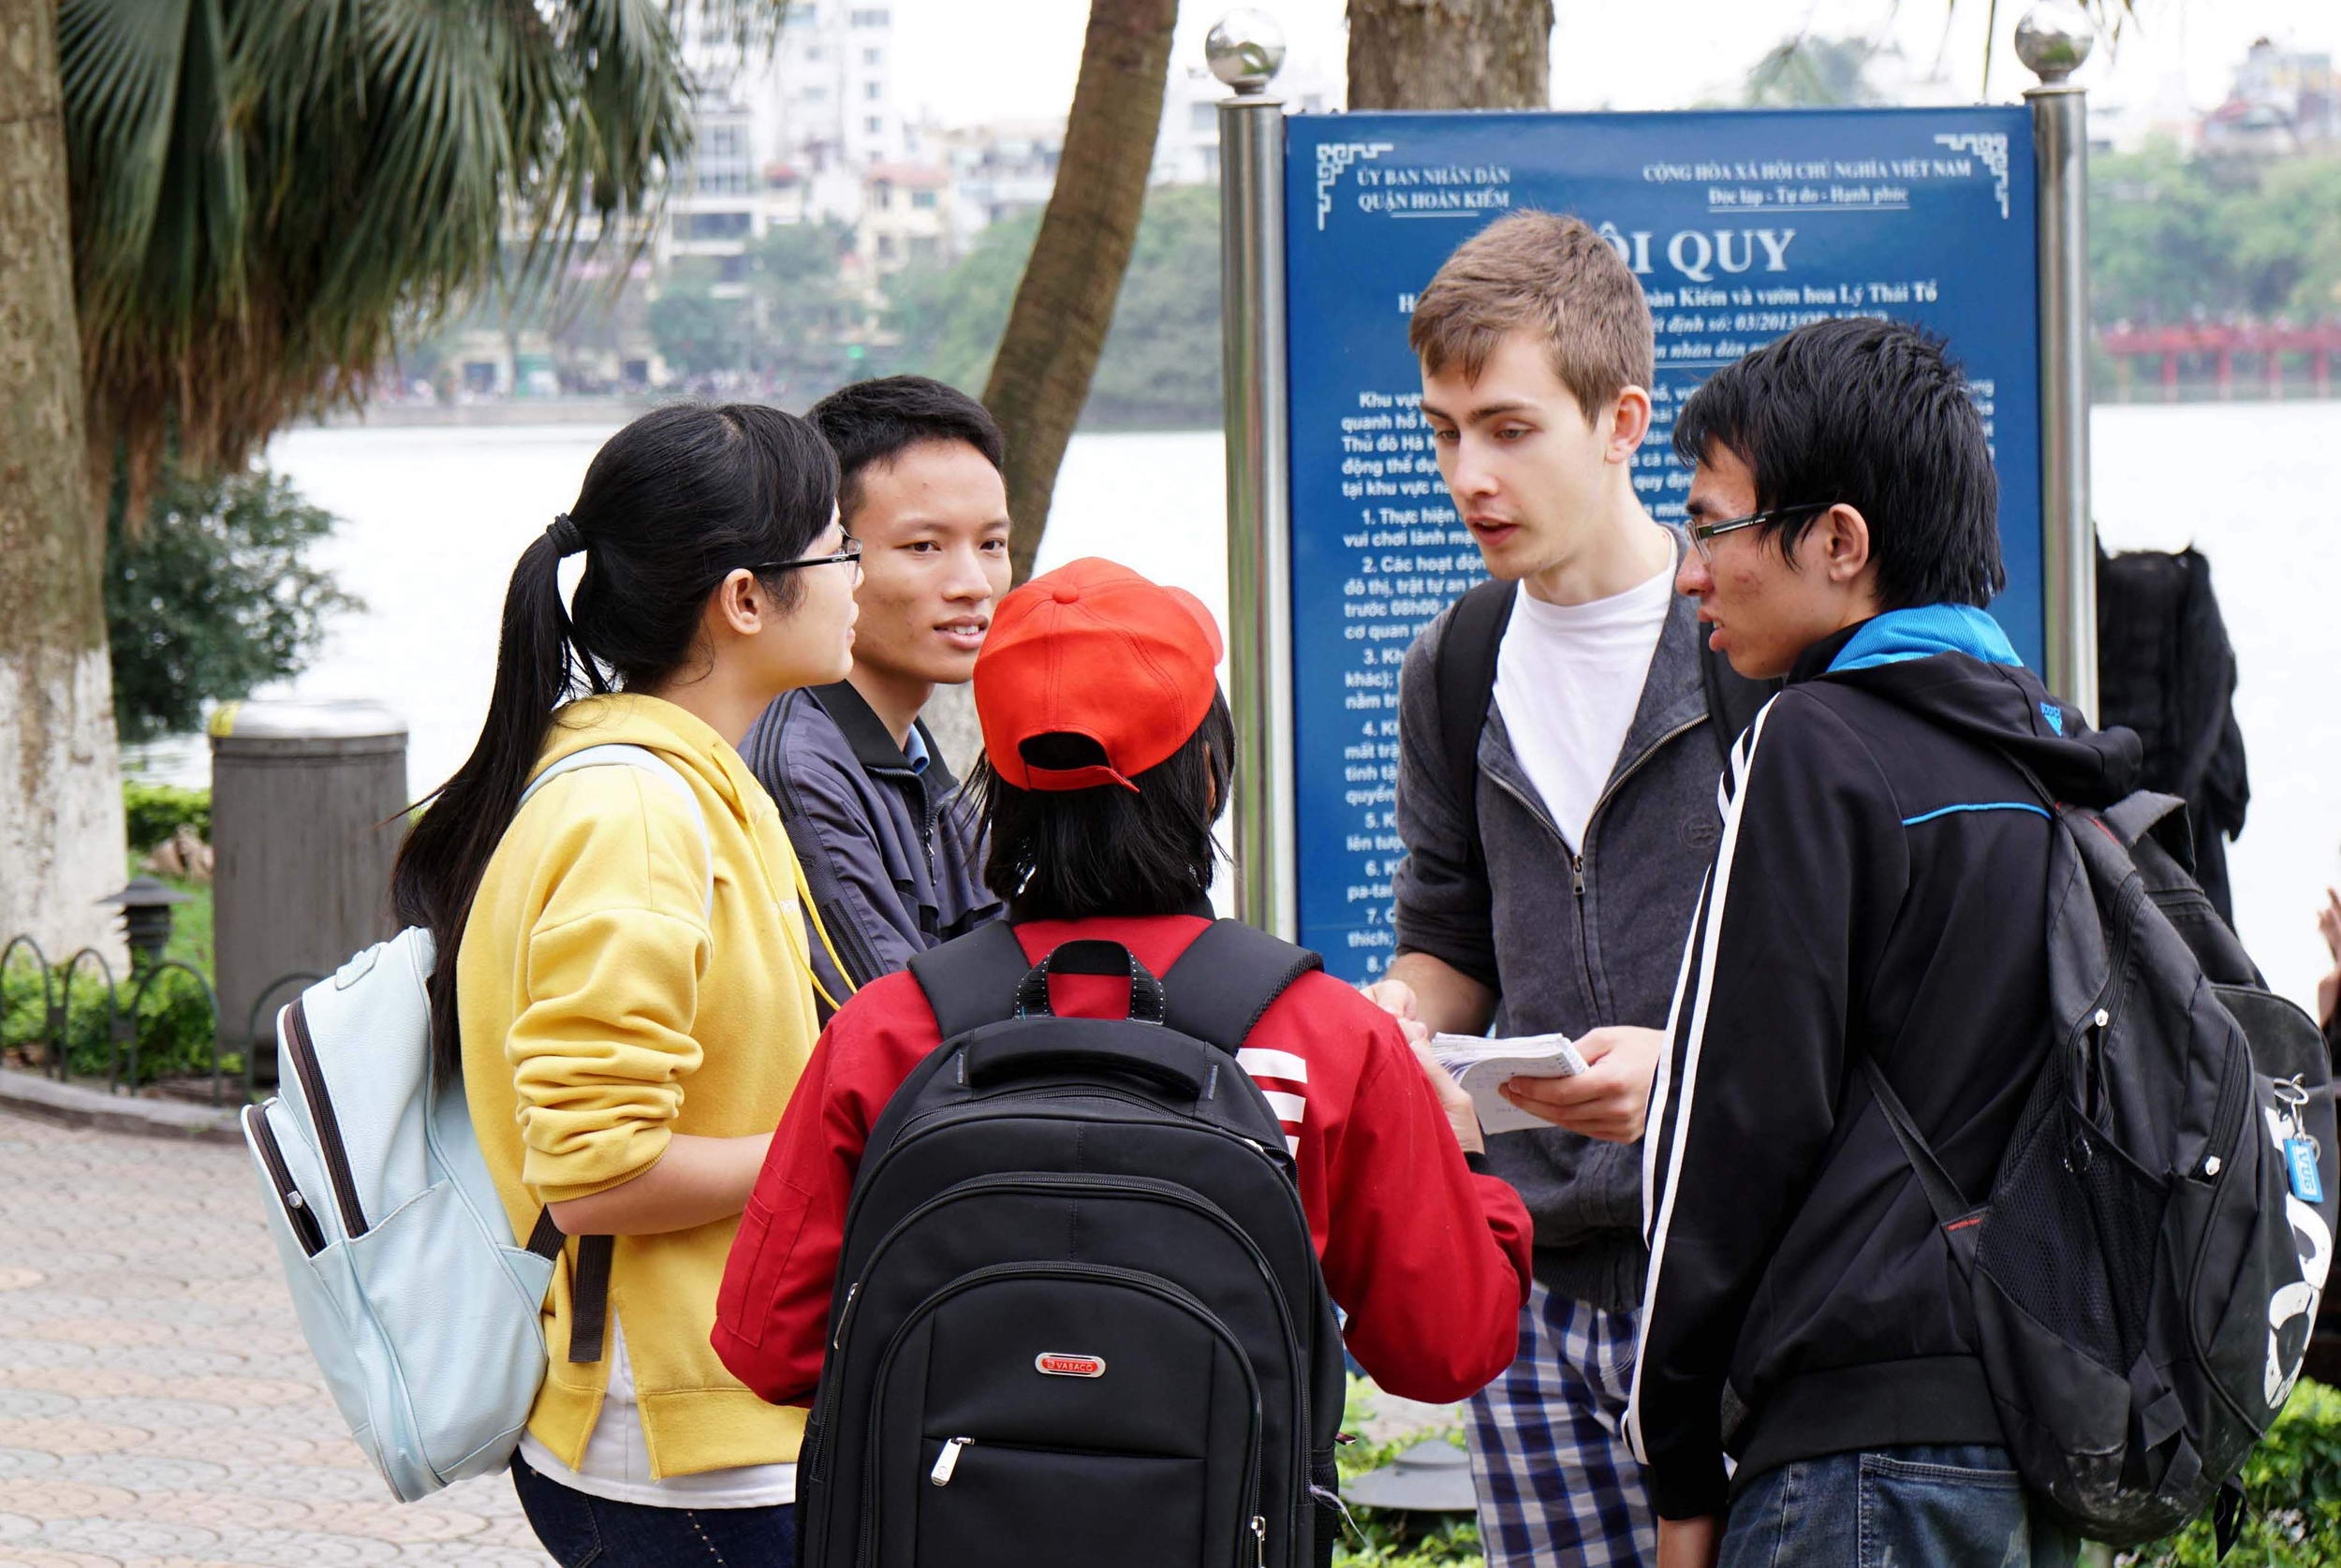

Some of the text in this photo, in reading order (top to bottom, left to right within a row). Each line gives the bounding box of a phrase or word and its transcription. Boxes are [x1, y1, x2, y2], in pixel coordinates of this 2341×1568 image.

[1384, 168, 1421, 186] BAN
[1642, 161, 1691, 184] CỘNG
[1761, 159, 1792, 183] HỘI
[1890, 157, 1929, 180] VIỆT
[1933, 158, 1972, 177] NAM
[1359, 191, 1408, 212] QUẬN
[1776, 186, 1797, 206] Tự
[1667, 227, 1796, 282] QUY
[1804, 284, 1836, 304] hoa
[1840, 284, 1863, 307] Lý
[1360, 391, 1392, 408] Khu
[1342, 413, 1392, 433] quanh
[1342, 432, 1374, 452] Thủ
[1342, 457, 1384, 478] động
[1415, 457, 1439, 476] dụ
[1343, 479, 1363, 501] tại
[1365, 479, 1397, 496] khu
[1400, 479, 1430, 498] vực
[1633, 470, 1696, 492] quy địn
[1362, 509, 1377, 526] 1.
[1379, 507, 1420, 528] Thực
[1421, 506, 1455, 527] hiện
[1343, 531, 1370, 548] vui
[1371, 530, 1407, 548] chơi
[1410, 527, 1446, 547] lành
[1362, 552, 1485, 575] 2. Các hoạt độn
[1396, 577, 1424, 597] trật
[1426, 578, 1444, 596] tự
[1446, 579, 1466, 593] an
[1344, 601, 1389, 618] trước
[1345, 624, 1366, 639] cơ
[1368, 623, 1410, 642] quan
[1363, 648, 1378, 666] 3.
[1362, 720, 1378, 737] 4.
[1364, 812, 1380, 829] 5.
[1365, 859, 1381, 877] 6.
[1366, 907, 1382, 925] 7.
[1366, 955, 1382, 973] 8.
